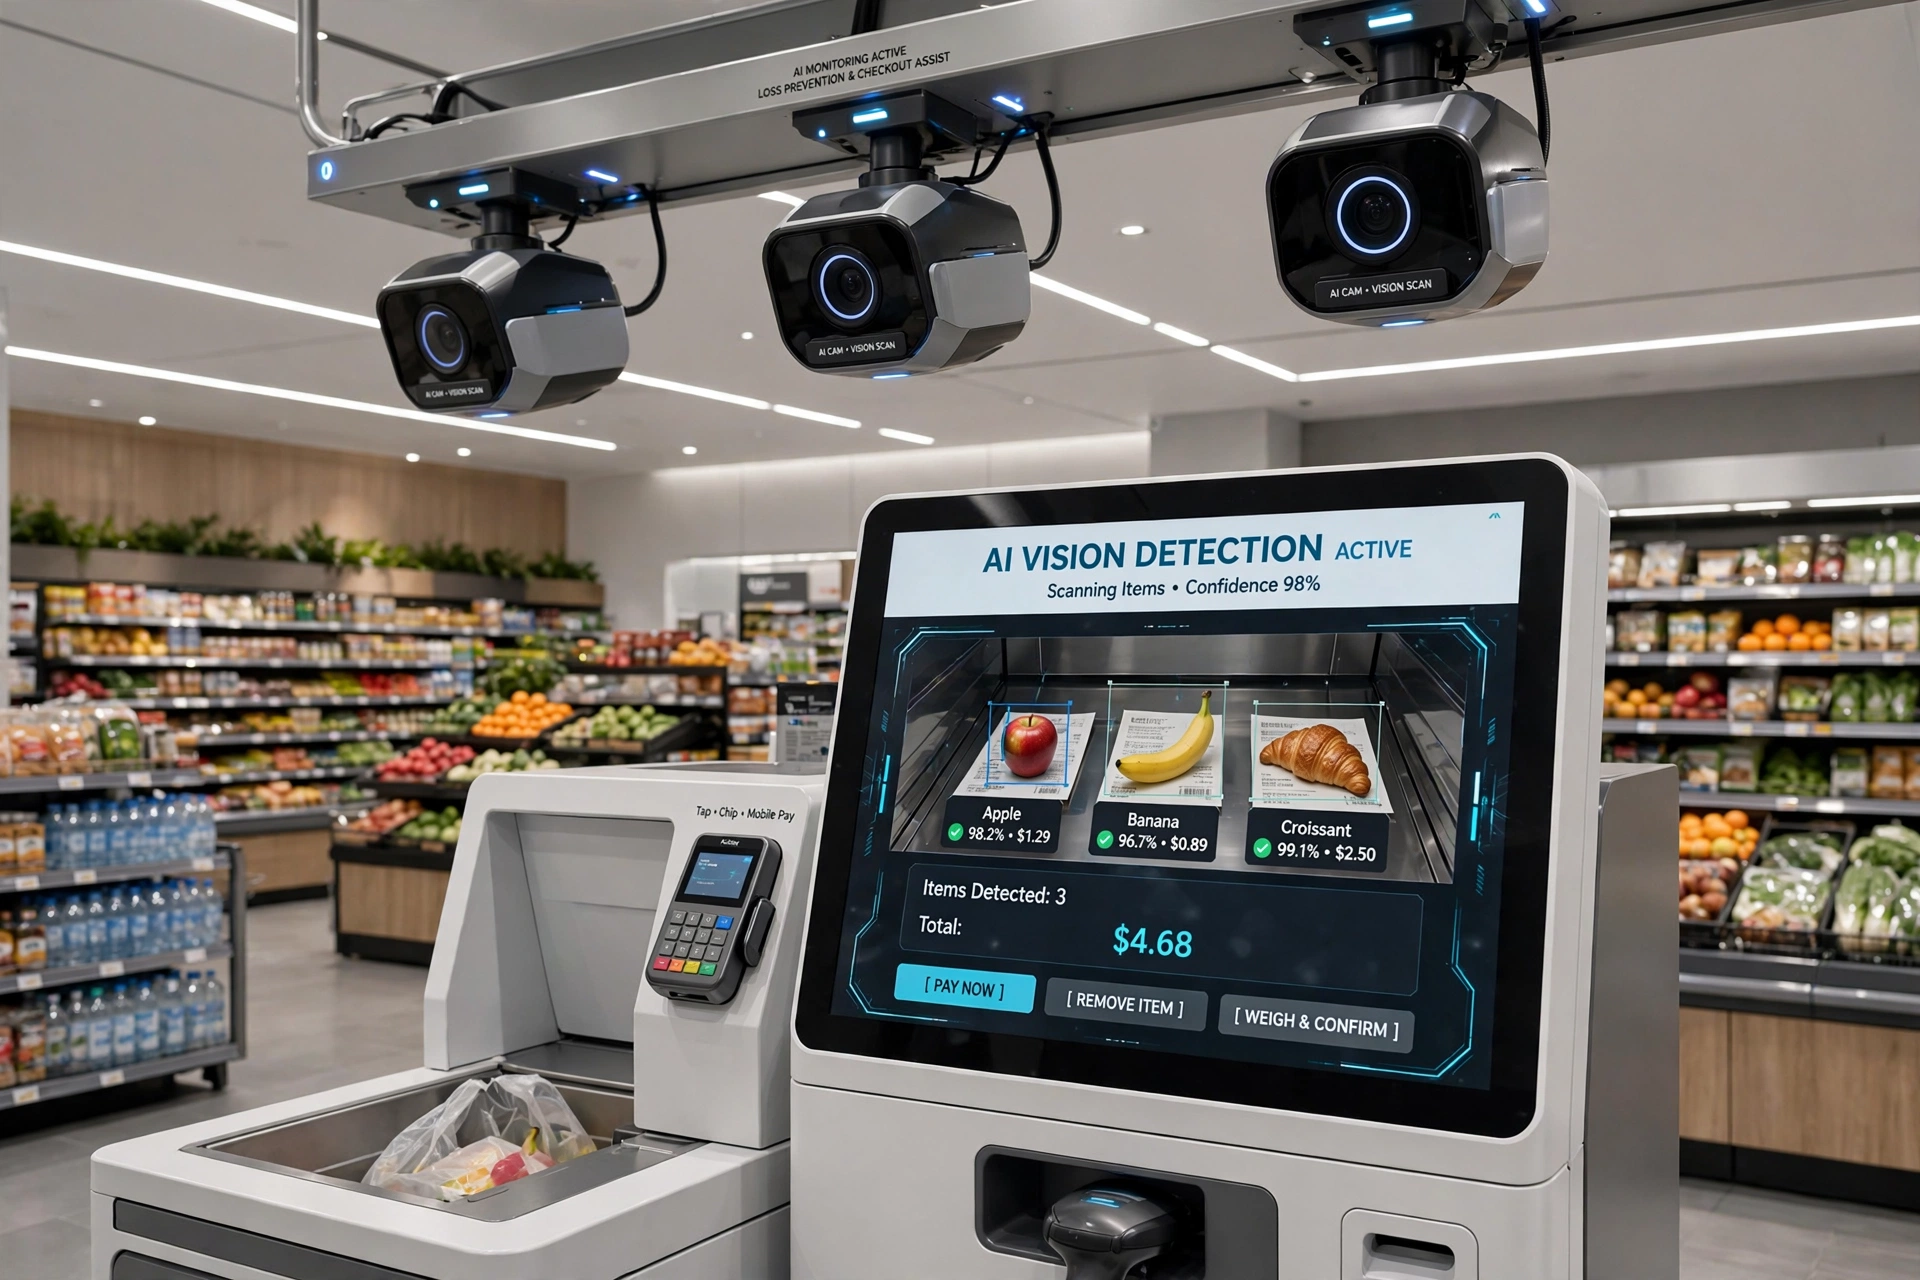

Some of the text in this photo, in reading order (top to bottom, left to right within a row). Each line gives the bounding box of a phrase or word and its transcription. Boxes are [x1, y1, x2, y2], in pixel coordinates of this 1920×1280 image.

[793, 45, 907, 78] AI MONITORING ACTIVE
[758, 51, 951, 99] LOSS PREVENTION & CHECKOUT ASSIST
[1329, 288, 1340, 298] AI
[1341, 286, 1363, 297] CAM
[1371, 282, 1405, 294] VISION
[1406, 279, 1432, 291] SCAN
[818, 348, 827, 356] AI
[827, 346, 844, 356] CAM
[850, 342, 875, 353] VISION
[875, 340, 896, 351] SCAN
[467, 386, 484, 395] SCAN
[982, 533, 1413, 573] AI VISION DETECTION ACTIVE
[1047, 582, 1117, 601] Scanning
[1122, 580, 1165, 596] Items
[1185, 577, 1279, 595] Confidence
[1283, 574, 1321, 592] 98%
[696, 805, 712, 819] Tap
[718, 806, 738, 820] Chip
[746, 808, 776, 820] Mobile
[777, 809, 795, 823] Pay
[982, 806, 1022, 824] Apple
[1127, 812, 1180, 829] Banana
[968, 826, 1005, 841] 98.2%
[1017, 828, 1051, 843] $1.29
[1281, 819, 1352, 838] Croissant
[1118, 834, 1158, 849] 96.7%
[1170, 835, 1208, 852] $0.89
[1277, 842, 1320, 859] 99.1%
[1335, 844, 1377, 862] $2.50
[923, 879, 1067, 905] Items Detected: 3
[919, 915, 1193, 958] Total: $4.68
[934, 978, 959, 995] PAY
[961, 980, 996, 997] NOW
[1076, 992, 1136, 1013] REMOVE
[1138, 997, 1174, 1016] ITEM
[1245, 1009, 1296, 1028] WEIGH
[1298, 1014, 1310, 1030] &
[1314, 1016, 1388, 1038] CONFIRM
